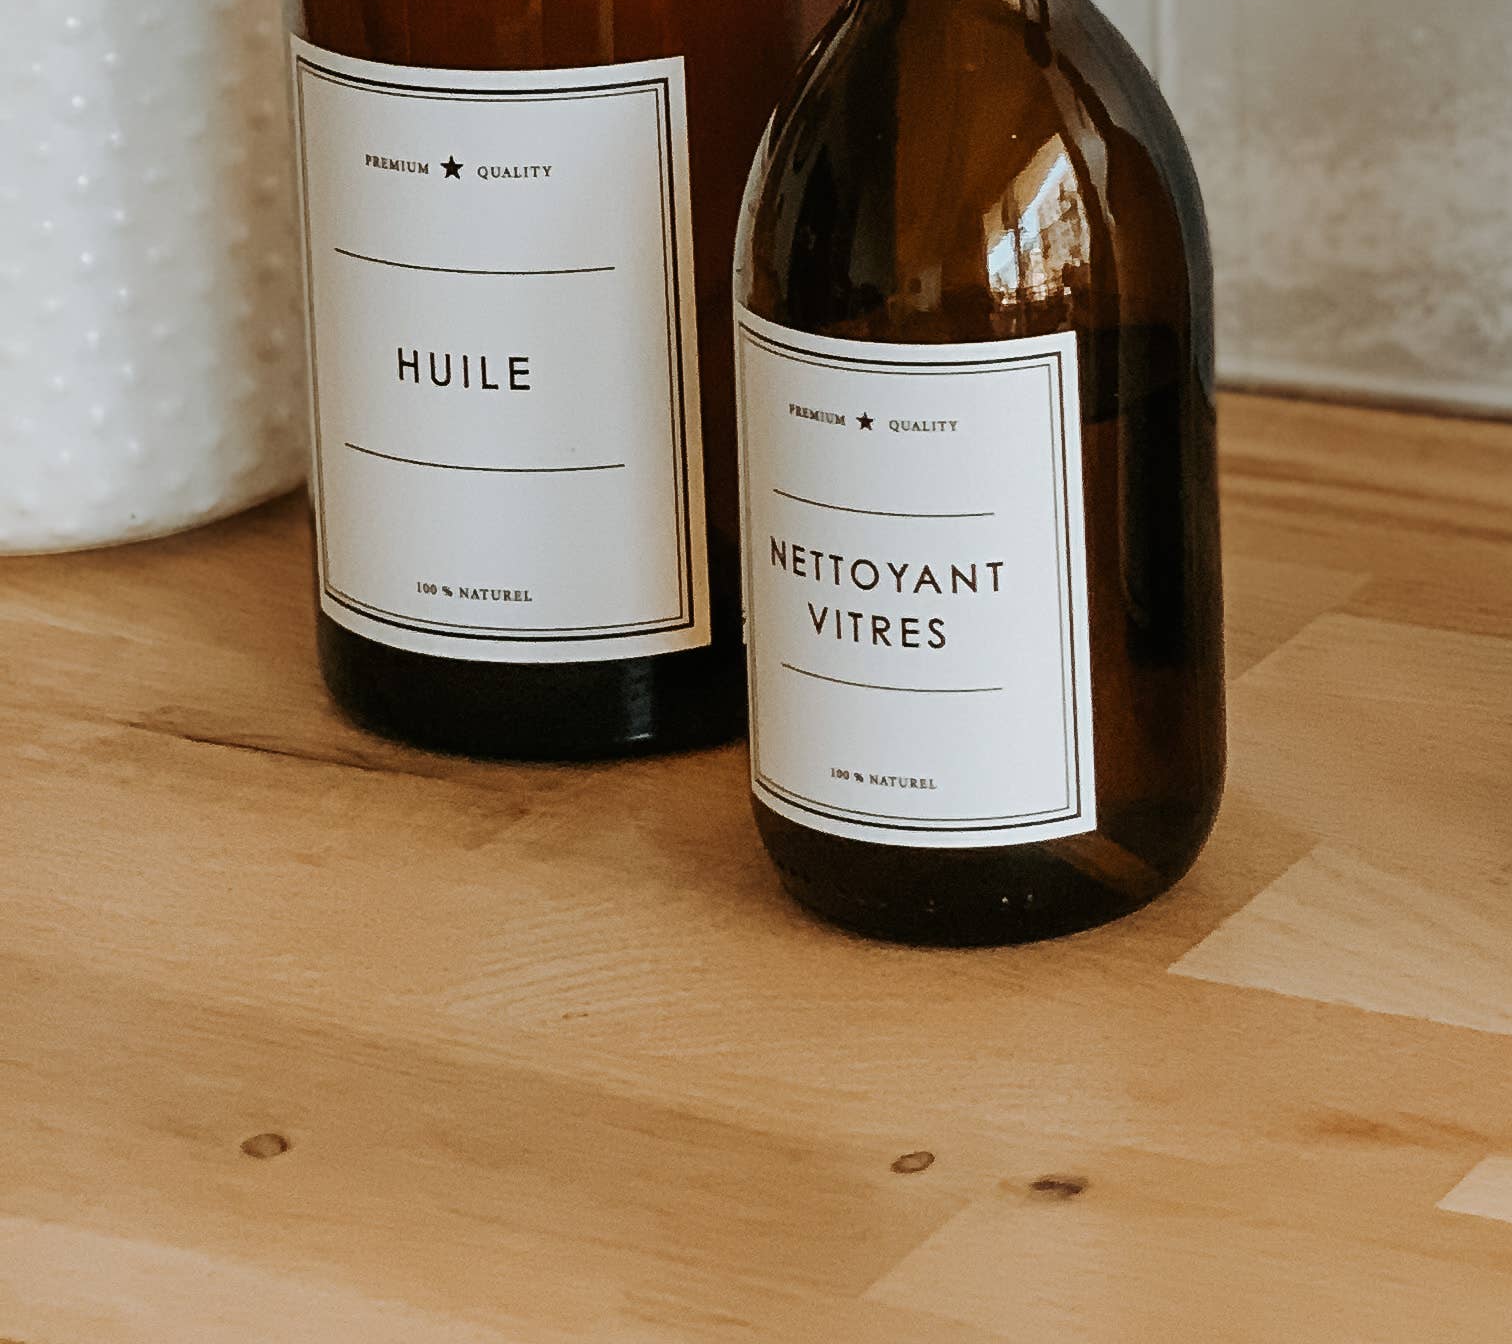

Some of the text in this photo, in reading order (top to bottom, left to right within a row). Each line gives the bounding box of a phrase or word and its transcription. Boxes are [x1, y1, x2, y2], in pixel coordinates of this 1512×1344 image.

[365, 153, 553, 180] PREMIUM QUALITY
[397, 346, 531, 391] HUILE
[788, 403, 958, 432] PREMIUM QUALITY
[769, 535, 1005, 595] NETTOYANT
[416, 581, 533, 602] 100 % NATUREL
[807, 602, 947, 649] VITRES
[830, 767, 849, 780] 100
[869, 773, 937, 790] NATUREL
